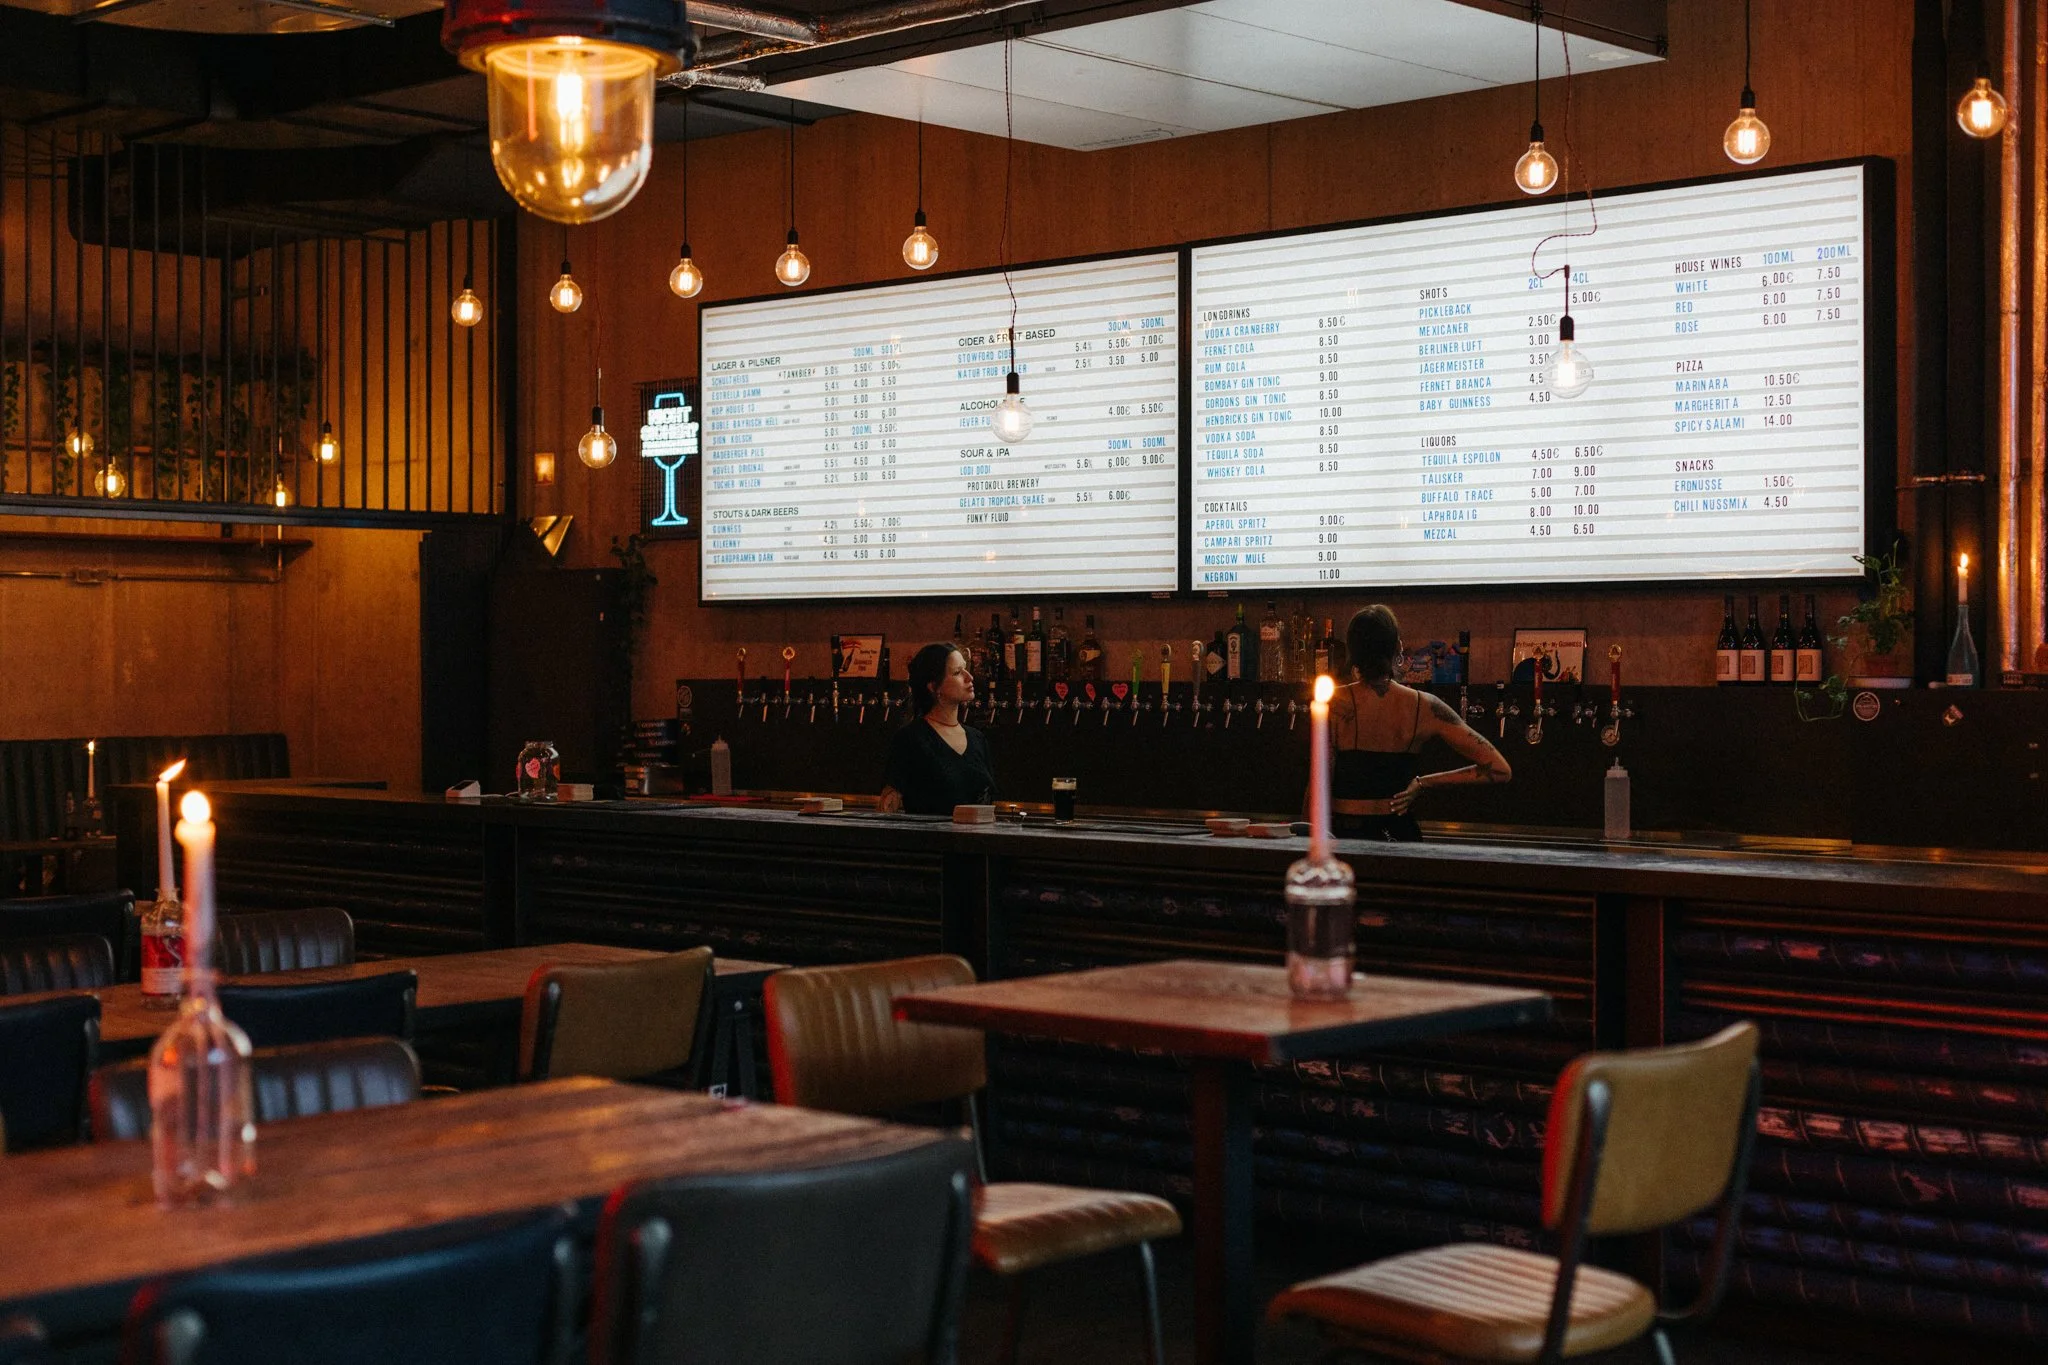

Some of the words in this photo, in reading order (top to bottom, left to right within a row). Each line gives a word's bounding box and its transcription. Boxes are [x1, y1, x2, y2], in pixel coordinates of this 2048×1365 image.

[1675, 260, 1705, 274] HOUSE
[1711, 257, 1742, 270] WINES
[1763, 252, 1795, 265] 100ML
[1817, 245, 1851, 260] 200ML
[1528, 278, 1543, 289] 2CL
[1572, 272, 1589, 283] 4CL
[1676, 280, 1708, 293] WHITE
[1762, 272, 1794, 287] 6.00€
[1817, 266, 1840, 280] 7.50
[1420, 288, 1448, 300] SHOTS
[1676, 301, 1693, 313] RED
[1763, 292, 1786, 305] 6.00
[1817, 287, 1840, 301] 7.50
[1419, 304, 1472, 319] PICKLEBACK
[1572, 291, 1601, 303] 5.00€
[1203, 308, 1251, 321] LONGDRINKS
[1675, 320, 1698, 333] ROSE
[1763, 313, 1786, 325] 6.00
[1817, 308, 1840, 321] 7.50
[1141, 317, 1165, 329] 500ML
[1205, 327, 1231, 339] VODKA
[1234, 323, 1280, 336] CRANBERRY
[1318, 316, 1346, 328] 8.50€
[1419, 323, 1469, 336] MEXICANER
[1529, 314, 1556, 327] 2.50€
[959, 336, 985, 347] CIDER
[988, 335, 995, 344] &
[996, 332, 1022, 343] FRIT
[1025, 329, 1056, 340] BASED
[1205, 345, 1232, 356] FERNET
[1234, 342, 1254, 354] COLA
[1319, 335, 1338, 346] 8.50
[1419, 343, 1459, 355] BERLINER
[1461, 340, 1482, 352] LUFT
[1529, 334, 1549, 346] 3.00
[712, 360, 738, 371] LAGER
[739, 359, 745, 369] &
[748, 357, 781, 368] PILSNER
[1109, 355, 1124, 366] 3.50
[1141, 352, 1159, 363] 5.00
[1205, 362, 1221, 373] RUM
[1226, 361, 1246, 372] COLA
[1319, 353, 1338, 364] 8.50
[1420, 359, 1484, 374] JAGERMEISTER
[1676, 360, 1703, 373] PIZZA
[1205, 378, 1238, 391] BOMBAY
[1241, 377, 1254, 388] GIN
[1257, 376, 1281, 387] TONIC
[1319, 371, 1338, 382] 9.00
[1420, 380, 1450, 392] FERNET
[1456, 377, 1491, 389] BRANCA
[1676, 378, 1729, 392] MARINARA
[1764, 372, 1800, 386] 10.50€
[1205, 397, 1240, 408] GORDONS
[1245, 396, 1258, 405] GIN
[1264, 393, 1286, 404] TONIC
[1319, 389, 1338, 400] 8.50
[1420, 399, 1442, 411] BABY
[1449, 396, 1491, 409] GUINNESS
[1529, 392, 1550, 403] 4.50
[1675, 398, 1739, 412] MARGHERITA
[1764, 394, 1792, 407] 12.50
[1205, 414, 1248, 426] HENDRICKS
[1251, 412, 1264, 423] GIN
[1269, 410, 1292, 422] TONIC
[1319, 407, 1342, 418] 10.00
[1675, 420, 1702, 433] SPICY
[1706, 417, 1745, 431] SALAMI
[1764, 414, 1792, 427] 14.00
[1205, 432, 1231, 444] VODKA
[1235, 431, 1256, 442] SODA
[1319, 425, 1338, 436] 8.50
[1421, 436, 1456, 447] LIQUORS
[960, 448, 984, 458] SOUR
[987, 449, 993, 457] &
[996, 448, 1010, 457] IPA
[1108, 438, 1132, 450] 300ML
[1142, 436, 1166, 447] 500ML
[1207, 449, 1239, 460] TEQUILA
[1243, 448, 1264, 458] SODA
[1319, 443, 1338, 454] 8.50
[1142, 454, 1164, 465] 9.00€
[1422, 454, 1458, 466] TEQUILA
[1463, 452, 1501, 464] ESPOLON
[1532, 448, 1560, 460] 4.50€
[1575, 445, 1603, 458] 6.50€
[1207, 467, 1241, 477] WHISKEY
[1245, 465, 1265, 475] COLA
[1319, 461, 1338, 472] 8.50
[1675, 459, 1714, 472] SNACKS
[1422, 472, 1463, 484] TALISKER
[1532, 468, 1552, 479] 7.00
[1574, 465, 1596, 477] 9.00
[1764, 476, 1794, 487] 1.50€
[967, 481, 1004, 491] PROTOKOLL
[1007, 478, 1040, 489] BREWERY
[960, 497, 985, 508] GELATO
[988, 495, 1020, 506] TROPICAL
[1023, 494, 1045, 505] SHAKE
[1421, 491, 1459, 503] BUFFALO
[1465, 490, 1493, 501] TRACE
[1531, 487, 1551, 498] 5.00
[1574, 485, 1595, 496] 7.00
[1205, 501, 1248, 513] COCKTAILS
[1530, 506, 1551, 517] 8.00
[1574, 504, 1599, 515] 10.00
[1674, 500, 1698, 512] CHILI
[1702, 498, 1748, 511] NUSSMIX
[1764, 496, 1788, 508] 4.50
[713, 509, 743, 519] STOUTS
[744, 509, 750, 518] &
[751, 508, 771, 517] DARK
[774, 507, 799, 516] BEERS
[967, 513, 988, 523] FUNKY
[991, 511, 1009, 522] FLUID
[1205, 520, 1234, 530] APEROL
[1238, 518, 1266, 529] SPRITZ
[1319, 515, 1345, 526] 9.00€
[1424, 529, 1457, 539] MEZCAL
[1530, 525, 1551, 536] 4.50
[1574, 523, 1594, 535] 6.50
[1205, 536, 1241, 547] CAMPARI
[1245, 535, 1272, 546] SPRITZ
[1319, 533, 1337, 543] 9.00
[1205, 555, 1238, 565] MOSCOW
[1245, 553, 1266, 563] MULE
[1318, 551, 1337, 561] 9.00
[1205, 572, 1238, 582] NEGRONI
[1319, 569, 1340, 580] 11.00
